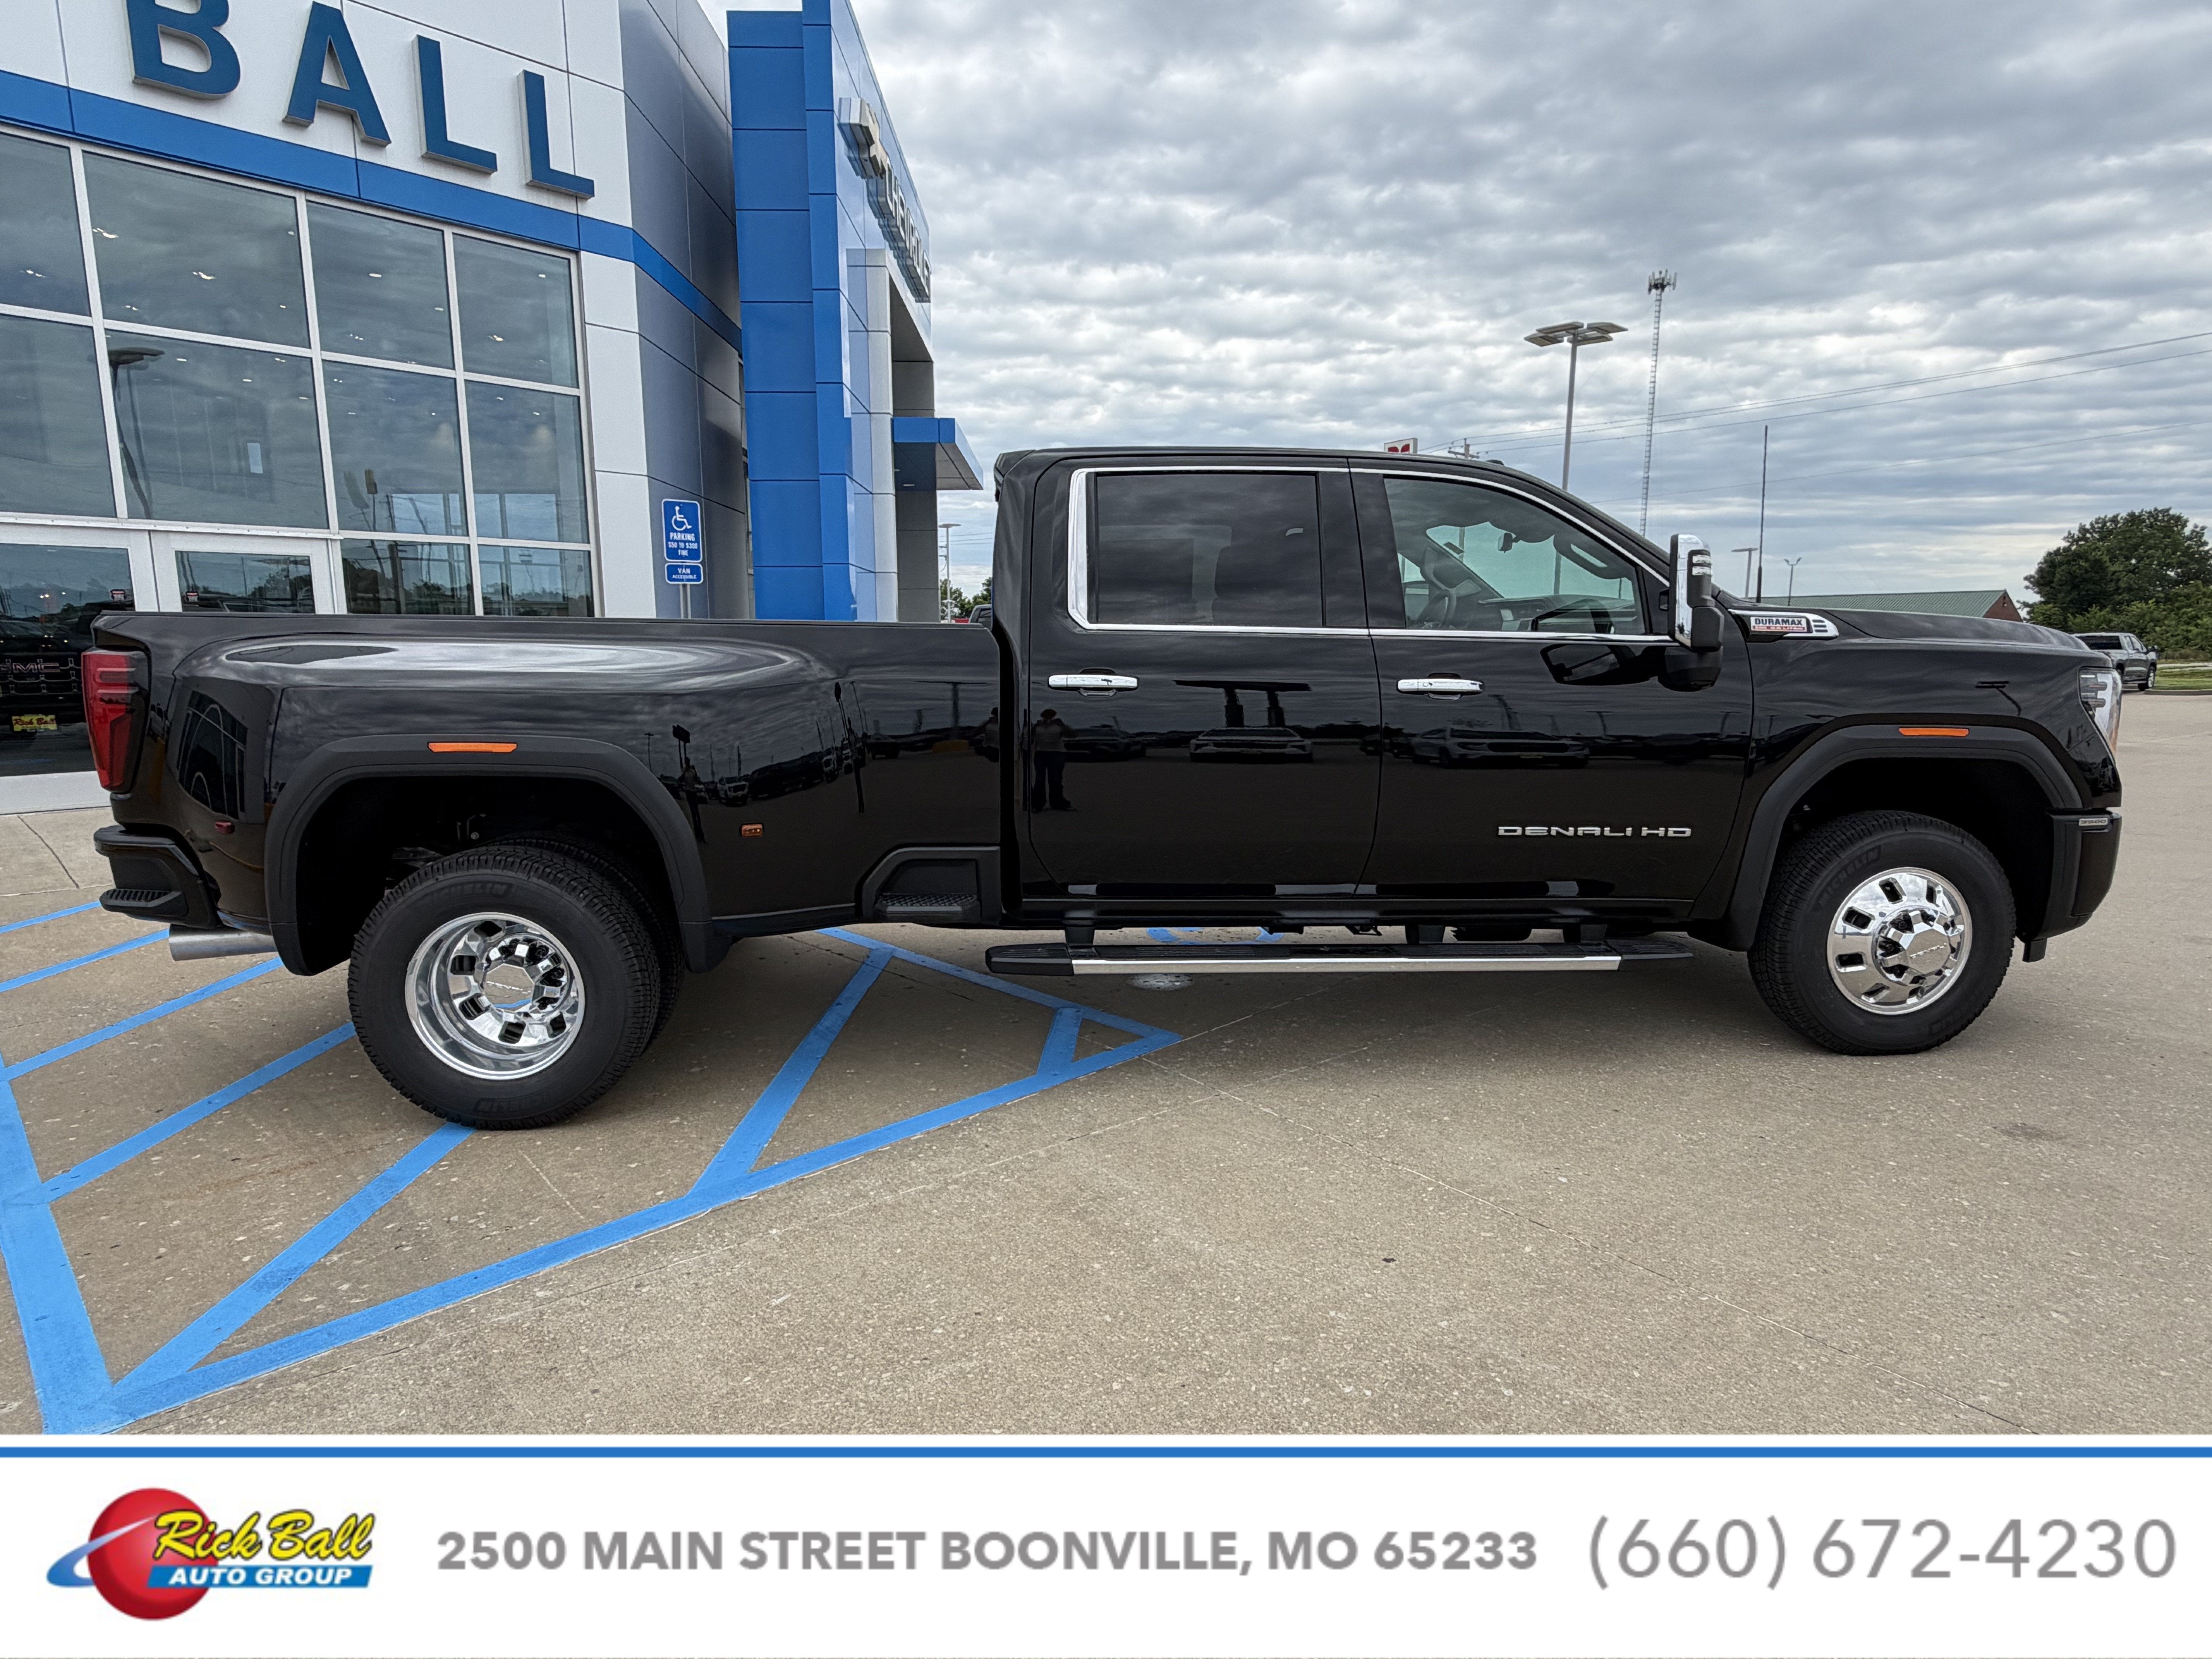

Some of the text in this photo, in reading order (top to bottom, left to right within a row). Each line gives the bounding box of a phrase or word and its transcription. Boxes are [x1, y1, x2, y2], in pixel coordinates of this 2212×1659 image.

[126, 0, 594, 199] BALL
[670, 532, 696, 541] PARKING
[1498, 826, 1692, 837] DENALI HD
